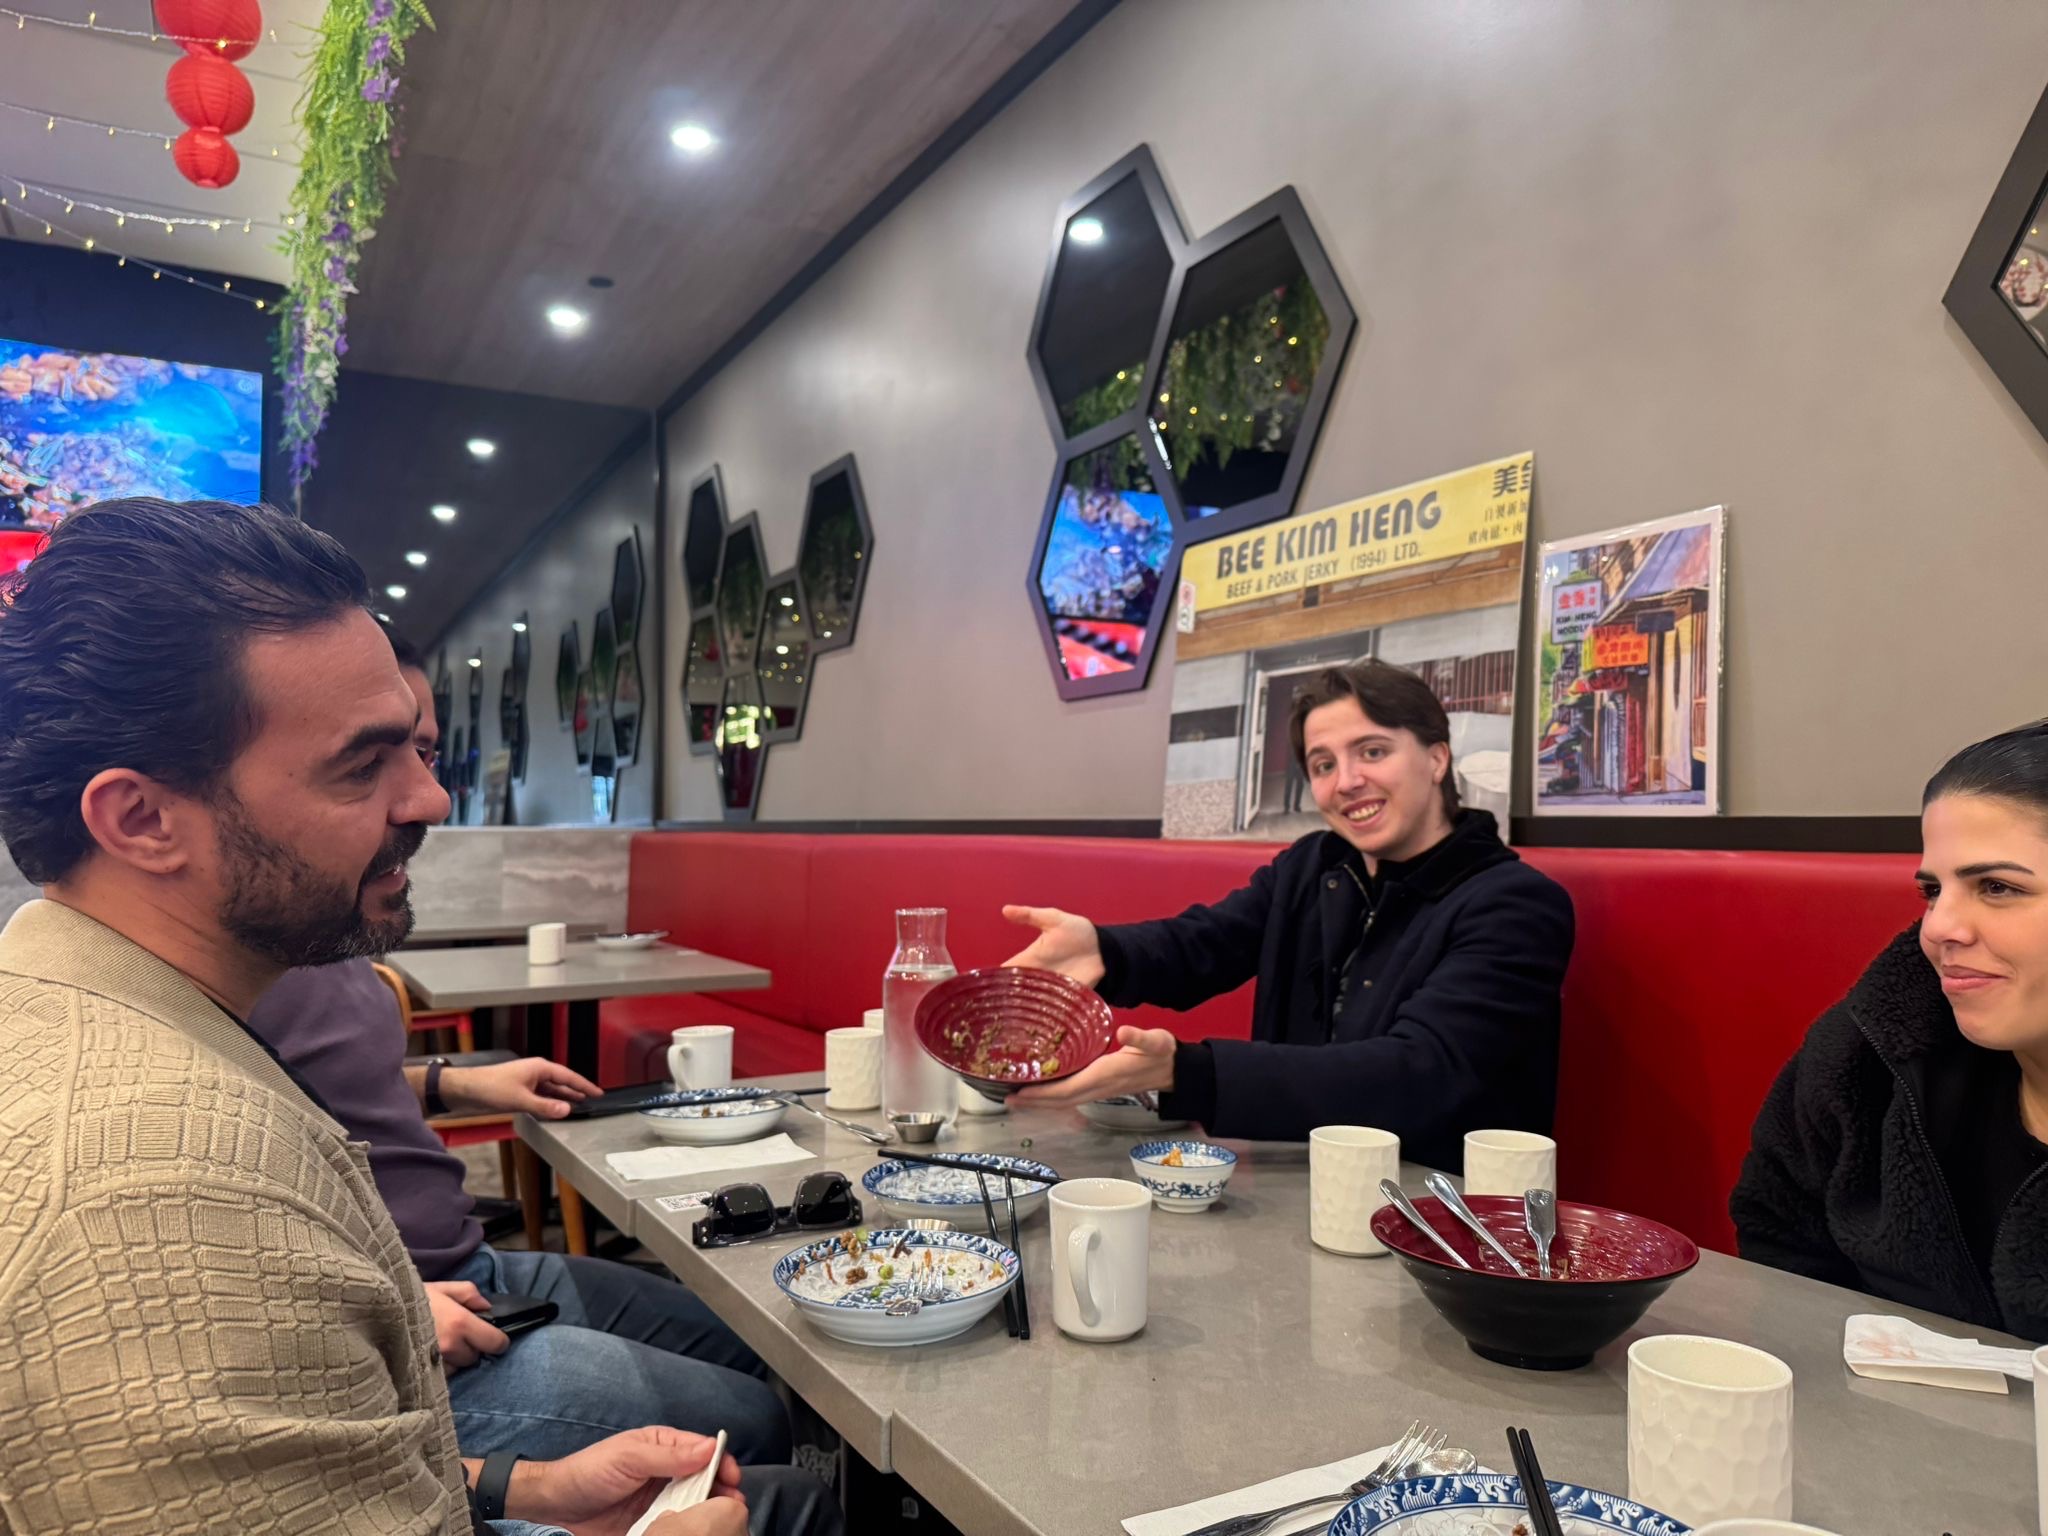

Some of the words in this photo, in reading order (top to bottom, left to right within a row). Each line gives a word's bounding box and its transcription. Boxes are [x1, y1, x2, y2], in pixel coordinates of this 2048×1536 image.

[1217, 536, 1265, 579] BEE
[1275, 517, 1337, 565] KIM
[1349, 490, 1441, 548] HENG
[1226, 579, 1253, 599] BEEF
[1256, 577, 1263, 593] &
[1267, 567, 1298, 590] PORK
[1304, 559, 1339, 587] JERKY
[1350, 548, 1387, 571] (1994)
[1394, 541, 1423, 561] LTD.
